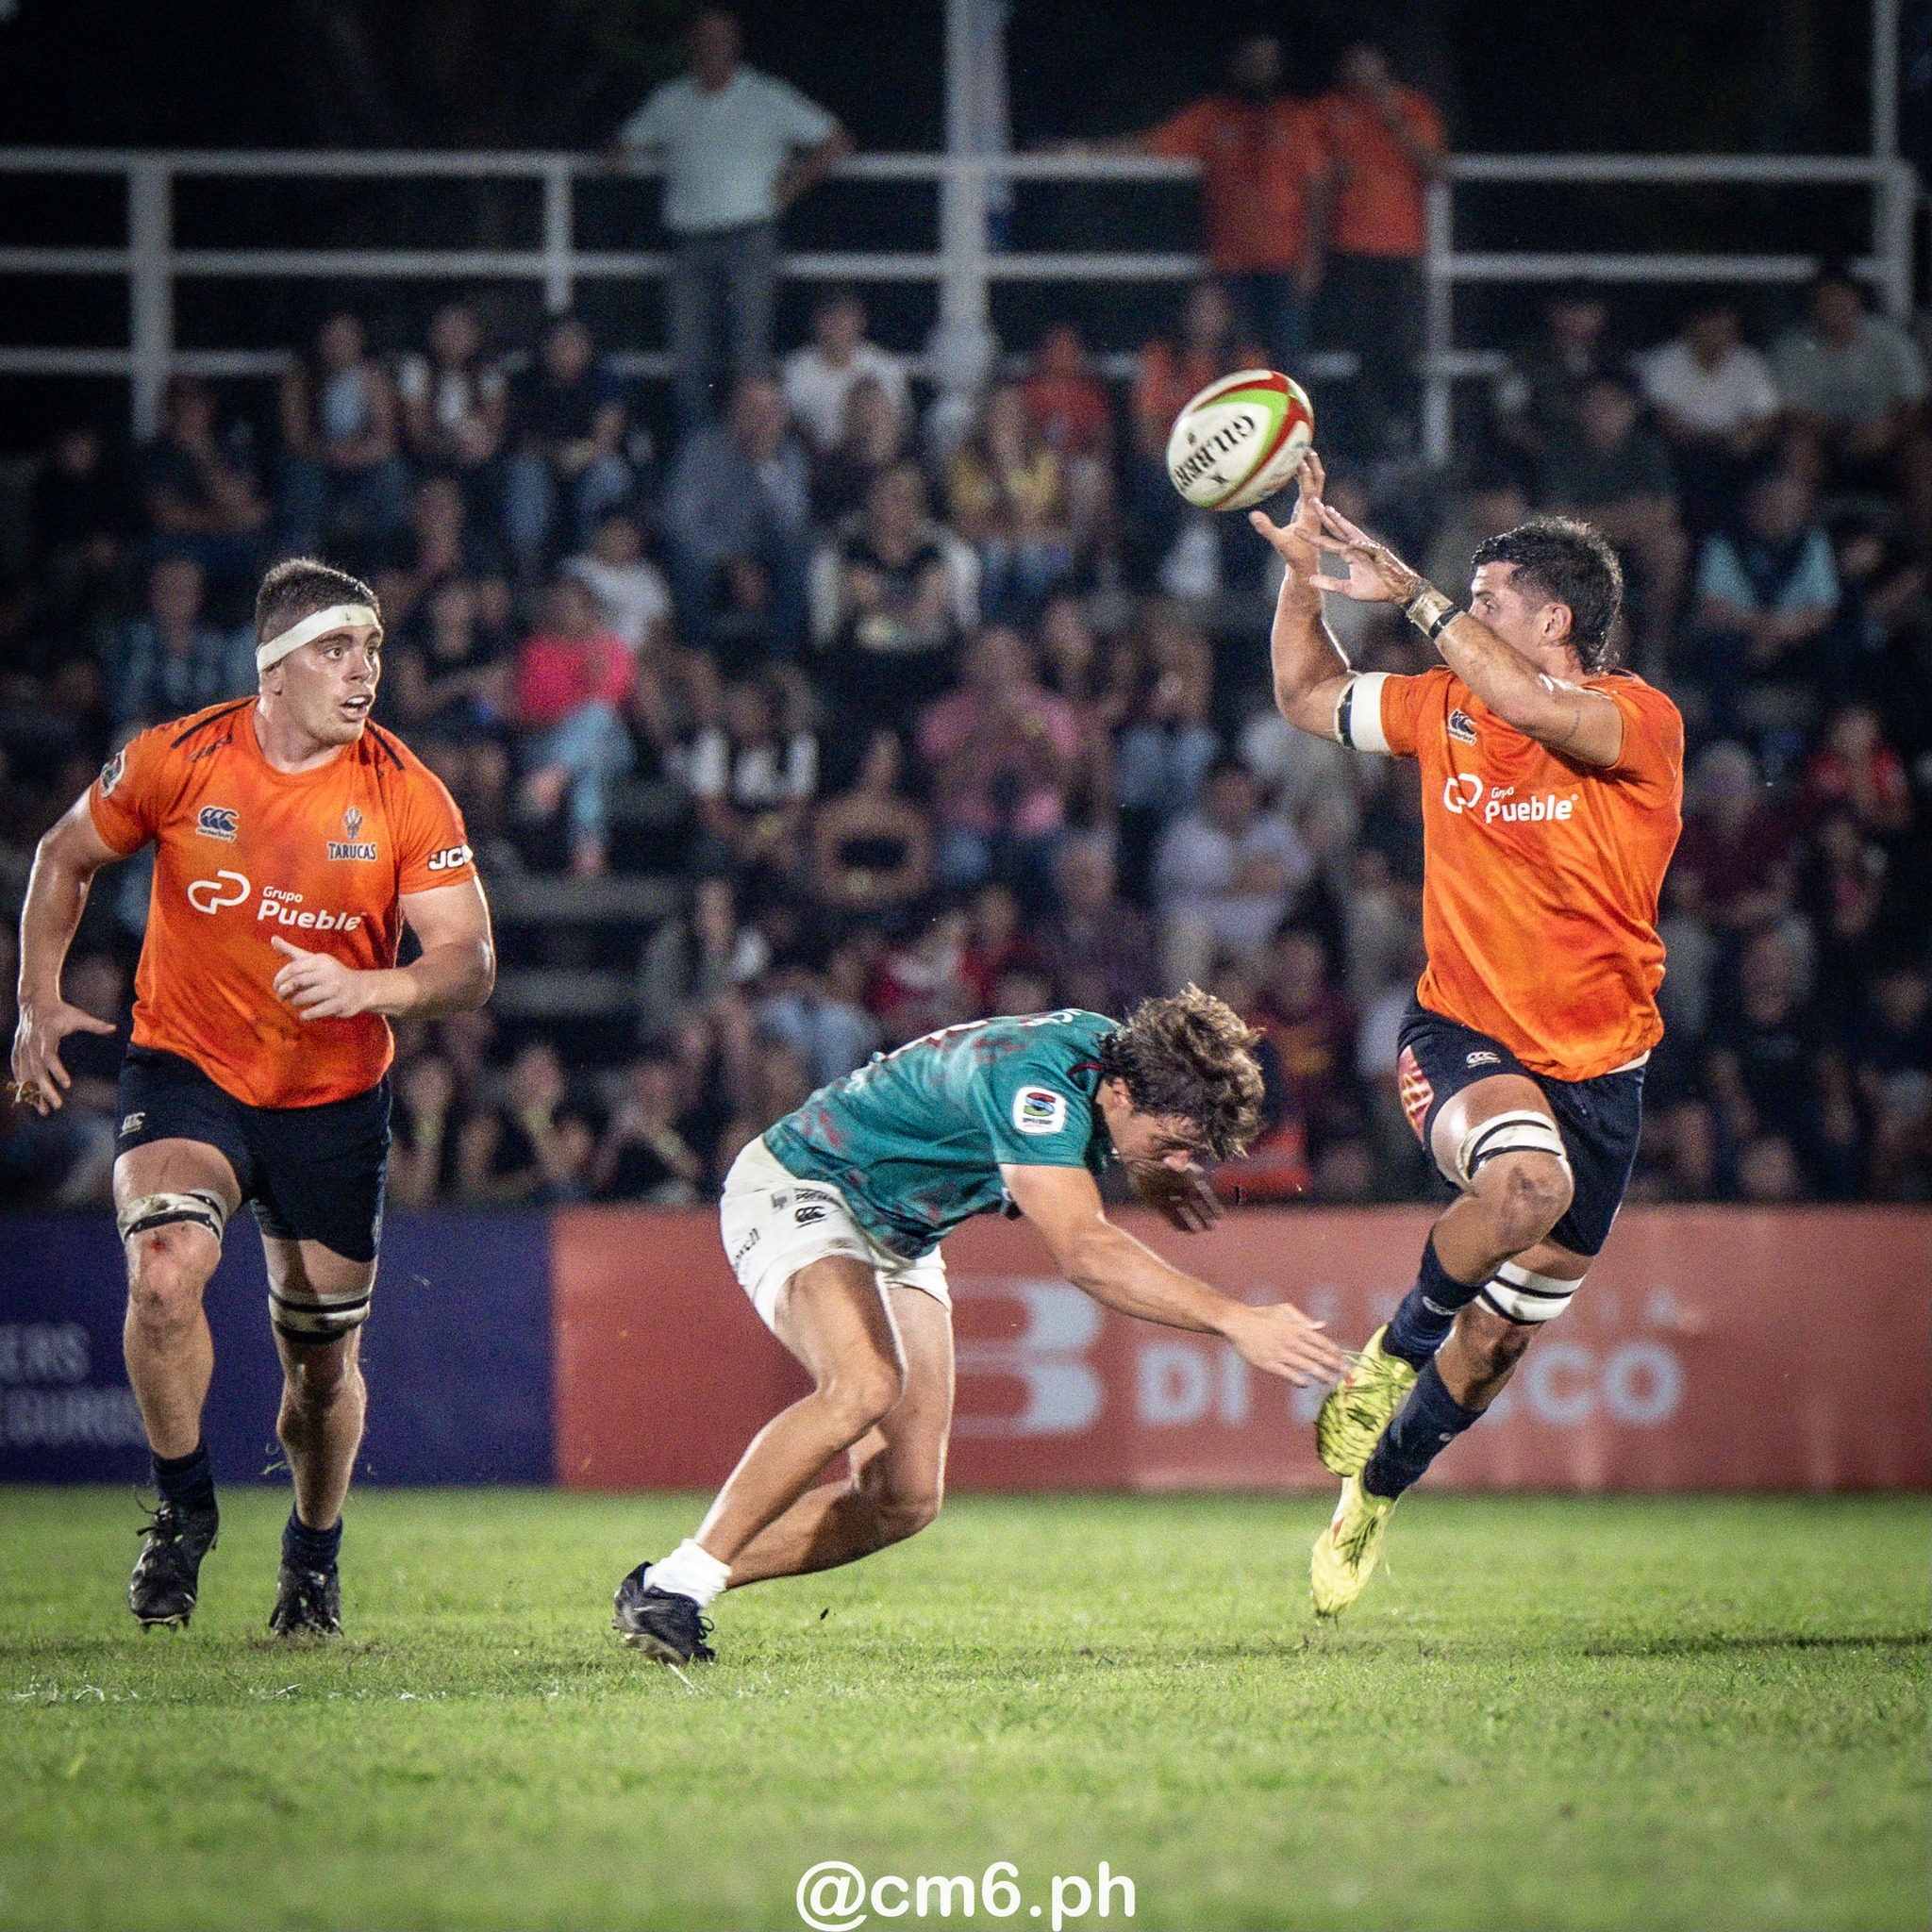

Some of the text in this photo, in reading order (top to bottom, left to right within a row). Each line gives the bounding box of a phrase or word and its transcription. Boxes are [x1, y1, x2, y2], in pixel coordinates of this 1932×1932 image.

[1173, 415, 1255, 491] GILBER
[327, 842, 377, 861] TARUCAS
[262, 885, 304, 904] Grupo
[257, 899, 361, 932] Pueble
